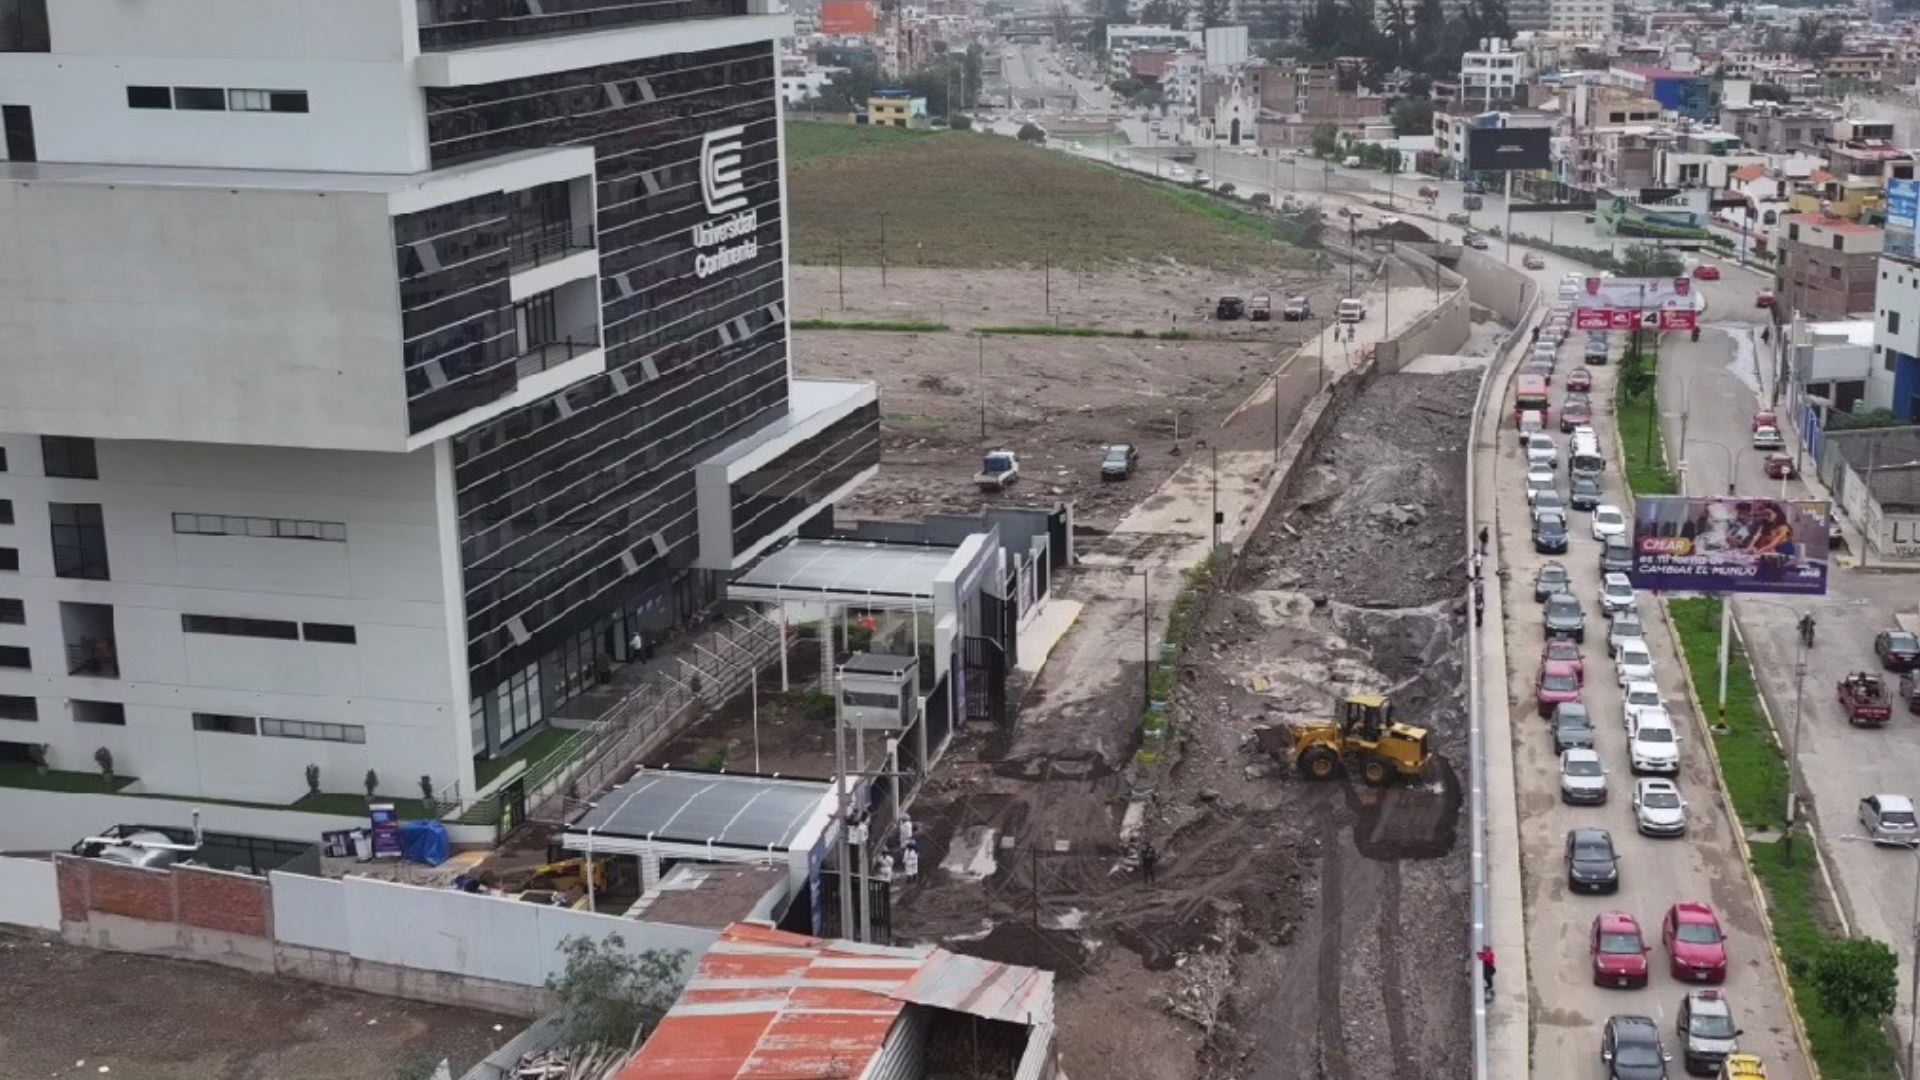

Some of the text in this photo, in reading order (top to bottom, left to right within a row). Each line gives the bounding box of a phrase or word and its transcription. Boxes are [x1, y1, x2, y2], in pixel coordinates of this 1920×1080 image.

[693, 208, 757, 247] Universidad
[695, 235, 757, 278] Continental
[1644, 312, 1657, 324] 4
[1642, 538, 1685, 550] CREAR
[1639, 565, 1758, 576] CAMBIAR EL MUNDO
